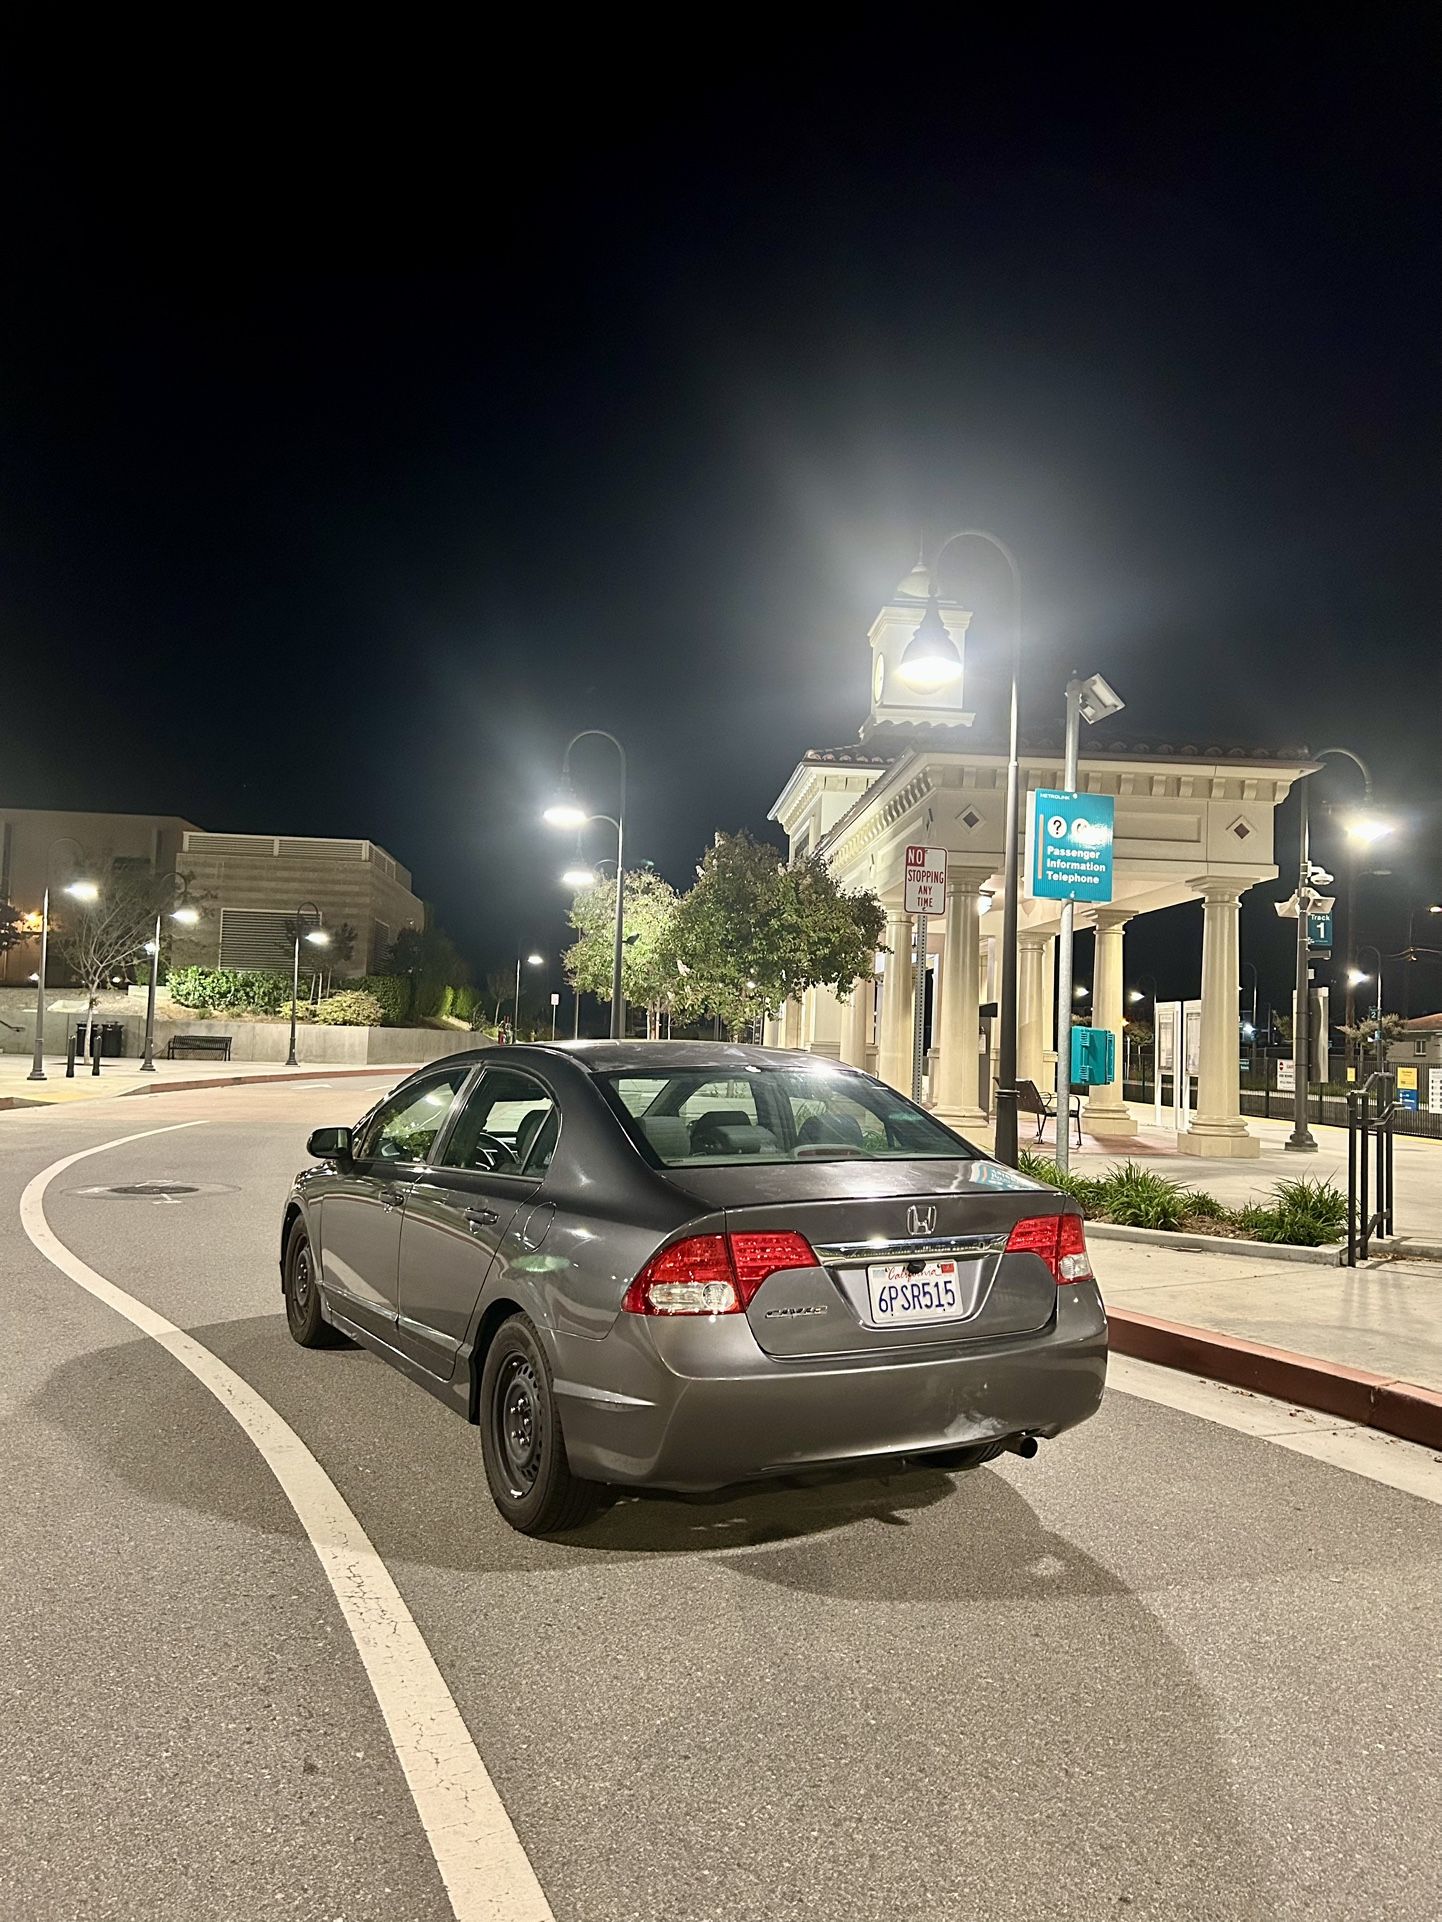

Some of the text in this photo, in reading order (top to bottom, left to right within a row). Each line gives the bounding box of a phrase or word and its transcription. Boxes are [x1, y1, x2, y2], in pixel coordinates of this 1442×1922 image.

[907, 848, 923, 864] NO
[1047, 845, 1101, 860] Passenger
[1046, 858, 1106, 872] Information
[907, 869, 944, 884] STOPPING
[1046, 870, 1100, 884] Telephone
[918, 885, 933, 895] ANY
[917, 897, 933, 907] TIME
[1316, 922, 1325, 939] 1
[879, 1280, 956, 1313] 6PSR515
